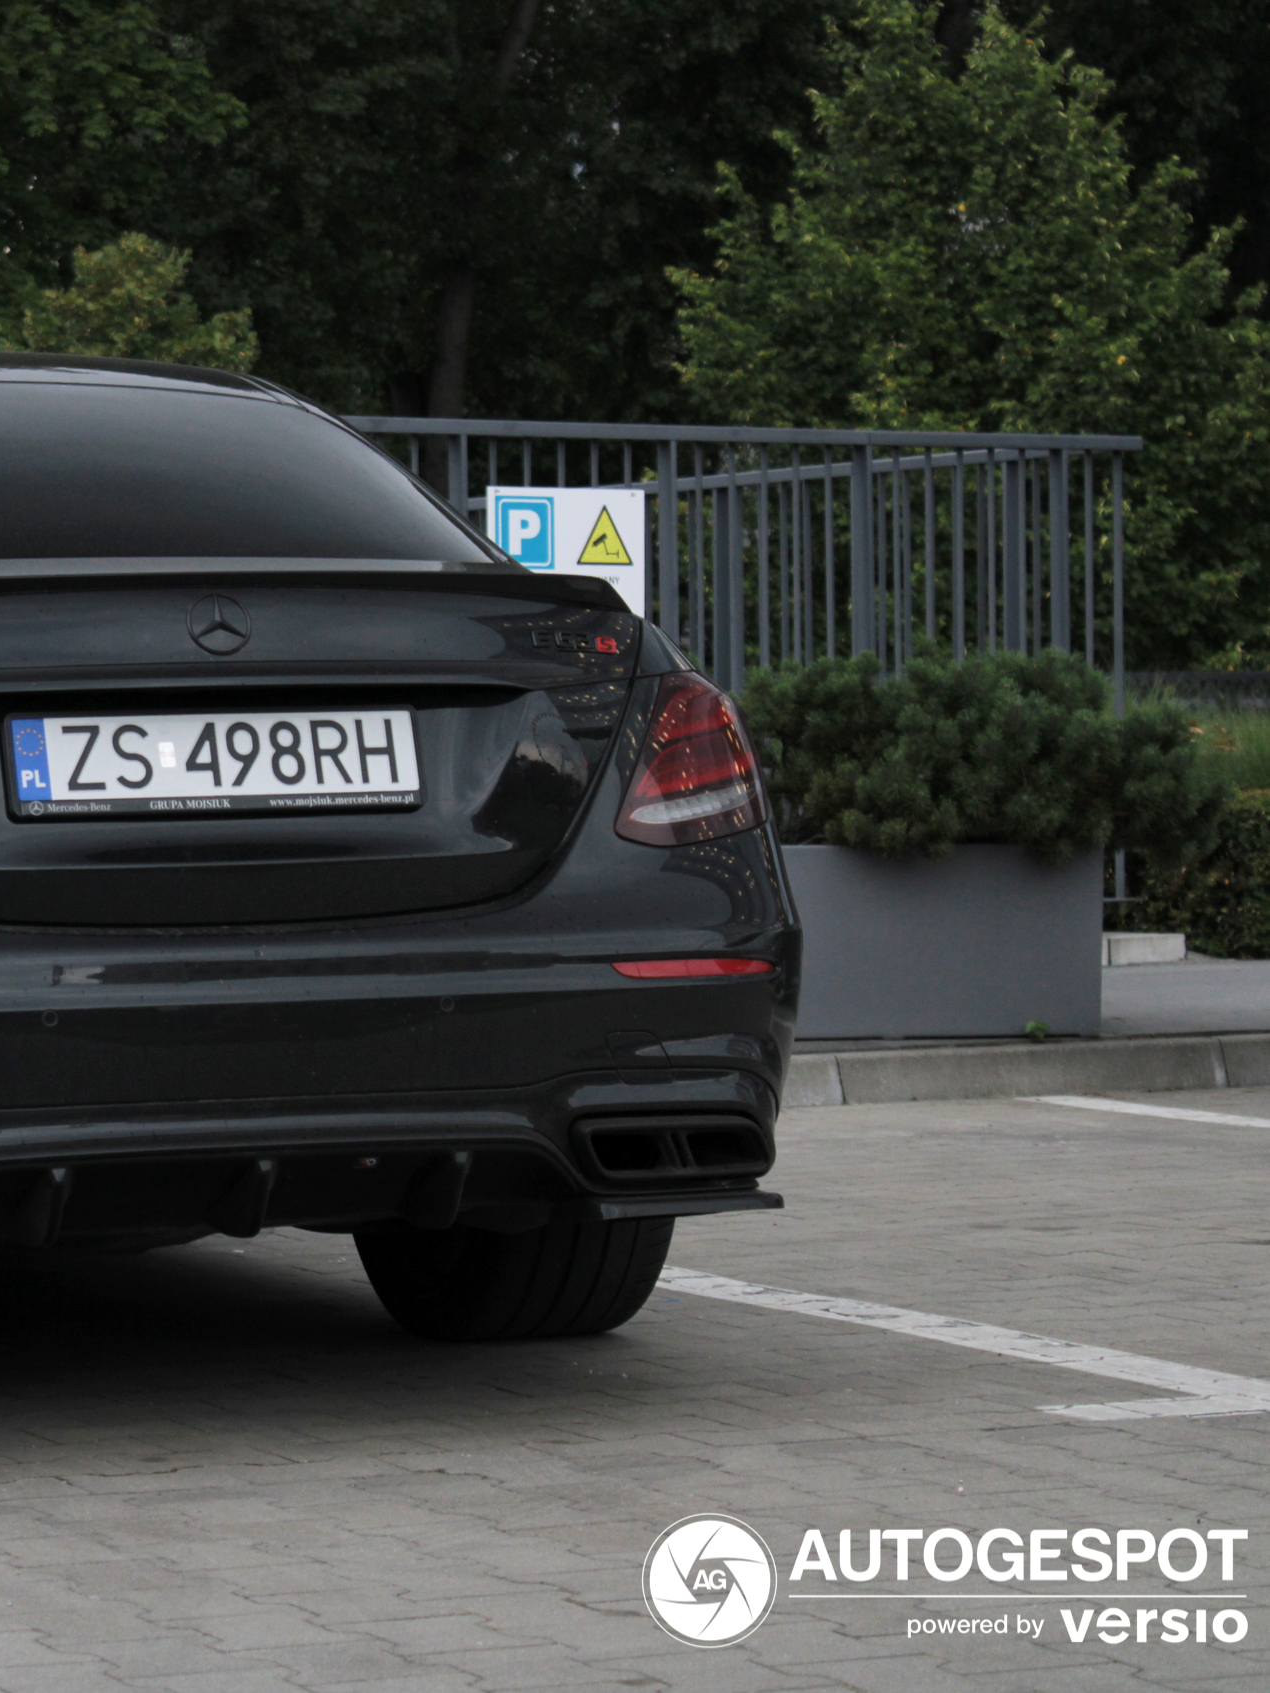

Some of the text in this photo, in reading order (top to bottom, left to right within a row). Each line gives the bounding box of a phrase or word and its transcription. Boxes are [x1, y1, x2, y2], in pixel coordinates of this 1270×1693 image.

[509, 509, 541, 555] P
[61, 718, 399, 791] ZS 498RH
[21, 770, 46, 789] PL
[48, 803, 111, 812] Mercedes-Benz
[150, 798, 231, 811] GRUPA MOJSIUK
[269, 794, 415, 808] www.mojsiuk.mercedes-benz.pl
